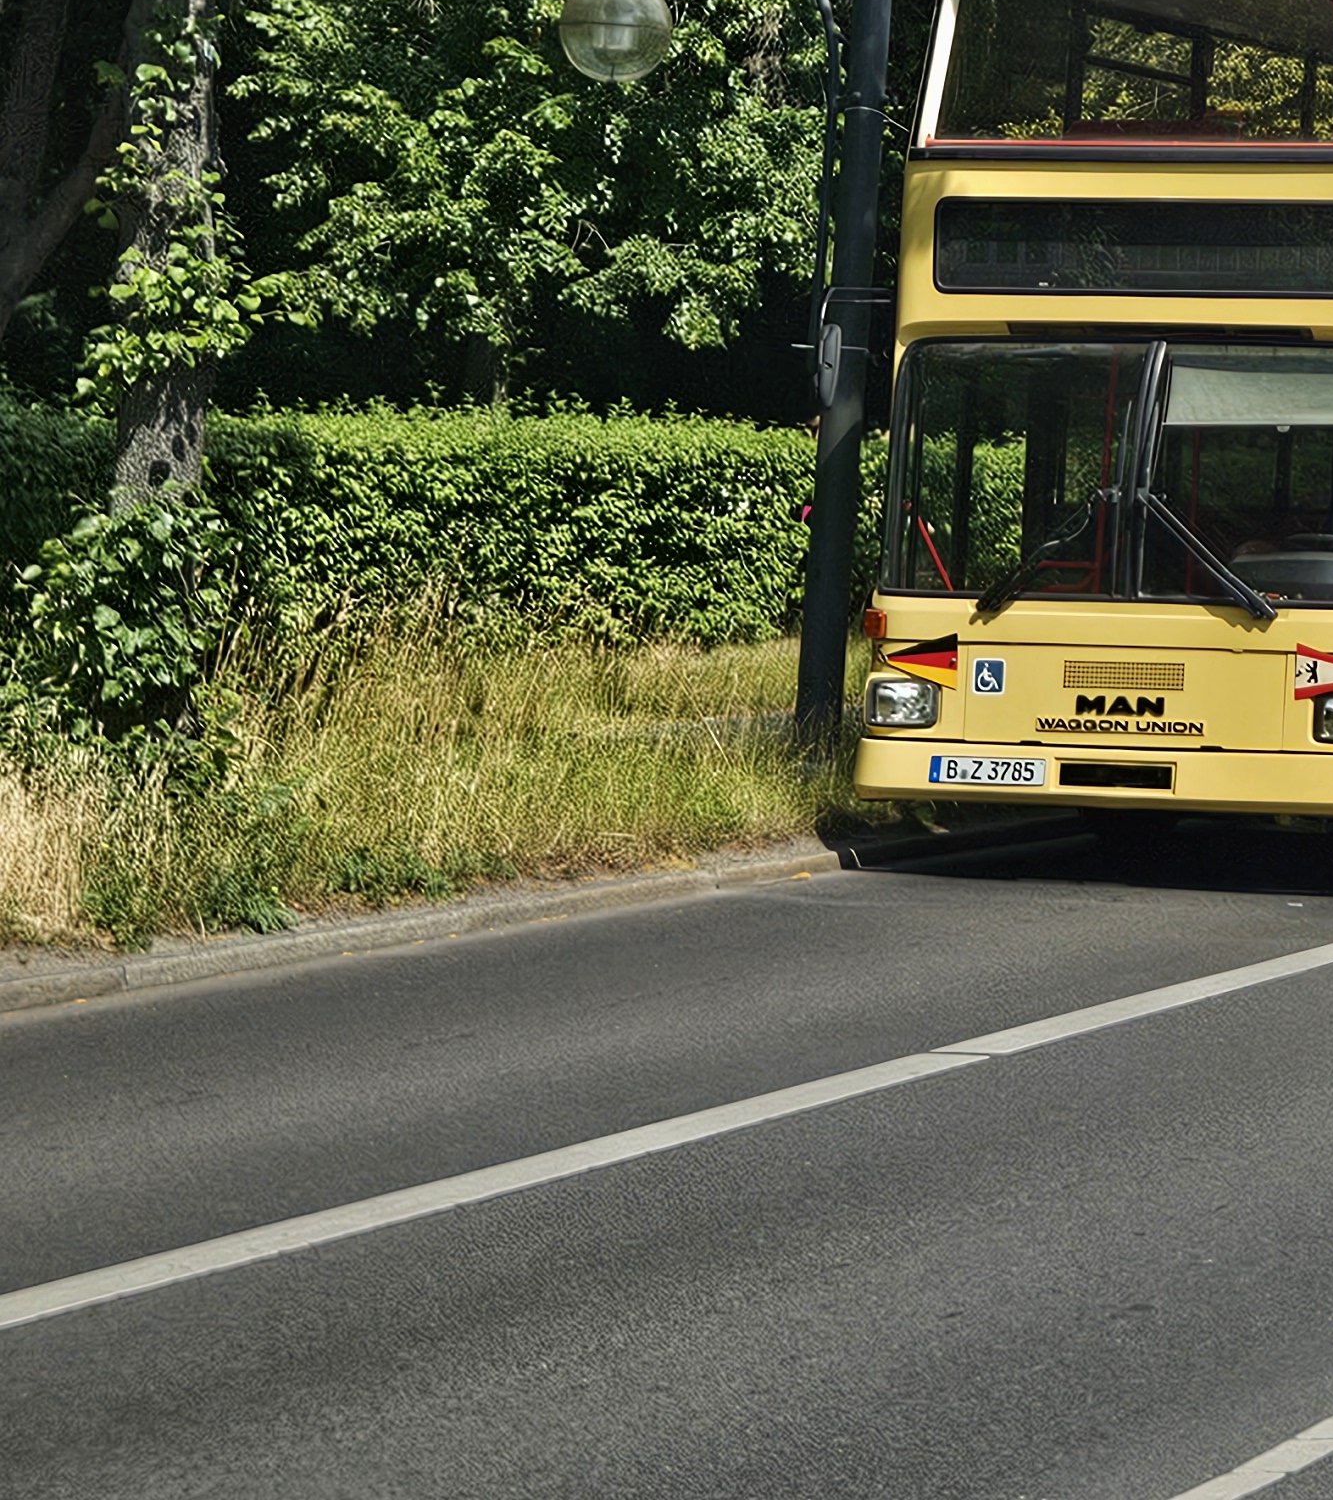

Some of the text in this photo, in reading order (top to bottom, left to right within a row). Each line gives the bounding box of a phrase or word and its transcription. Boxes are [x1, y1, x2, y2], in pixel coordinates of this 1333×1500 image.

[1075, 694, 1165, 717] MAN
[1037, 717, 1204, 734] WAGGON UNION
[946, 759, 1035, 781] B Z 3785
